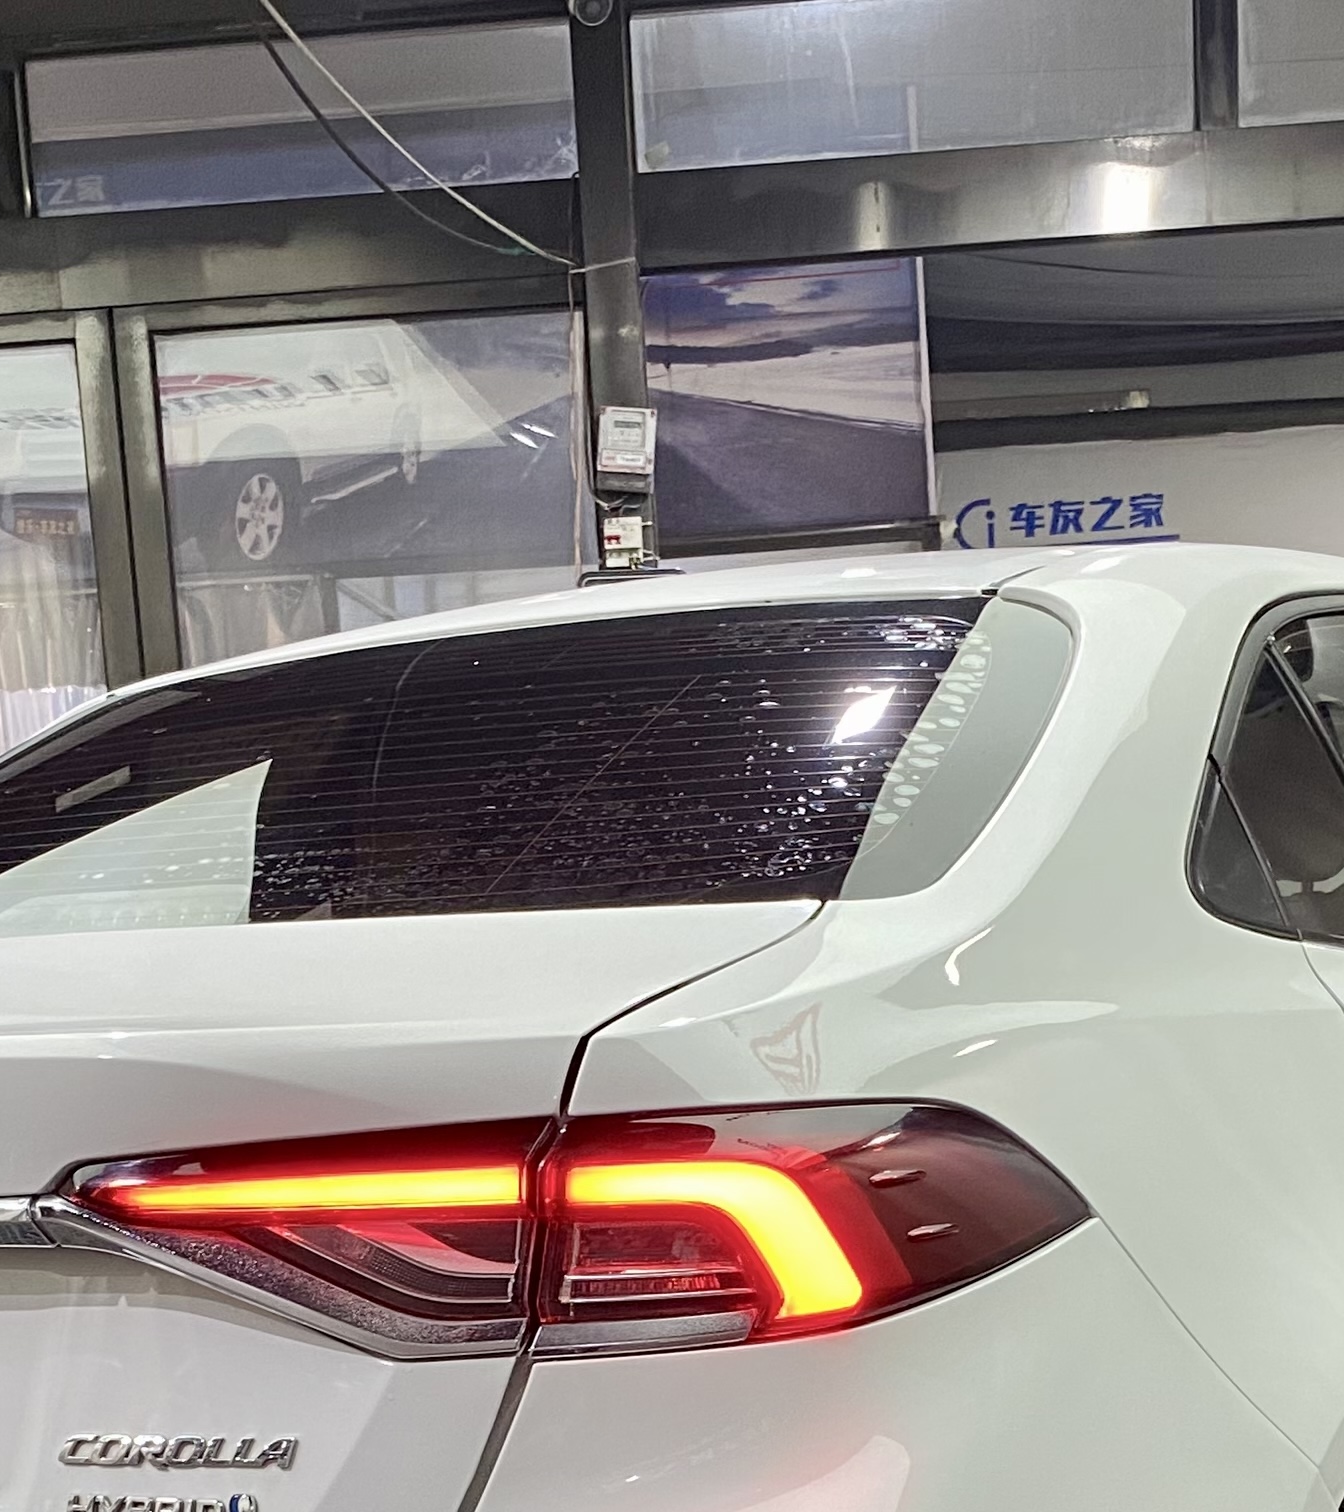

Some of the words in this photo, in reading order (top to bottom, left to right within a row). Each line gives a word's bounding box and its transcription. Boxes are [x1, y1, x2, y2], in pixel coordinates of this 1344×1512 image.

[1009, 493, 1164, 538] 车友之家
[58, 1434, 299, 1471] COROLLA
